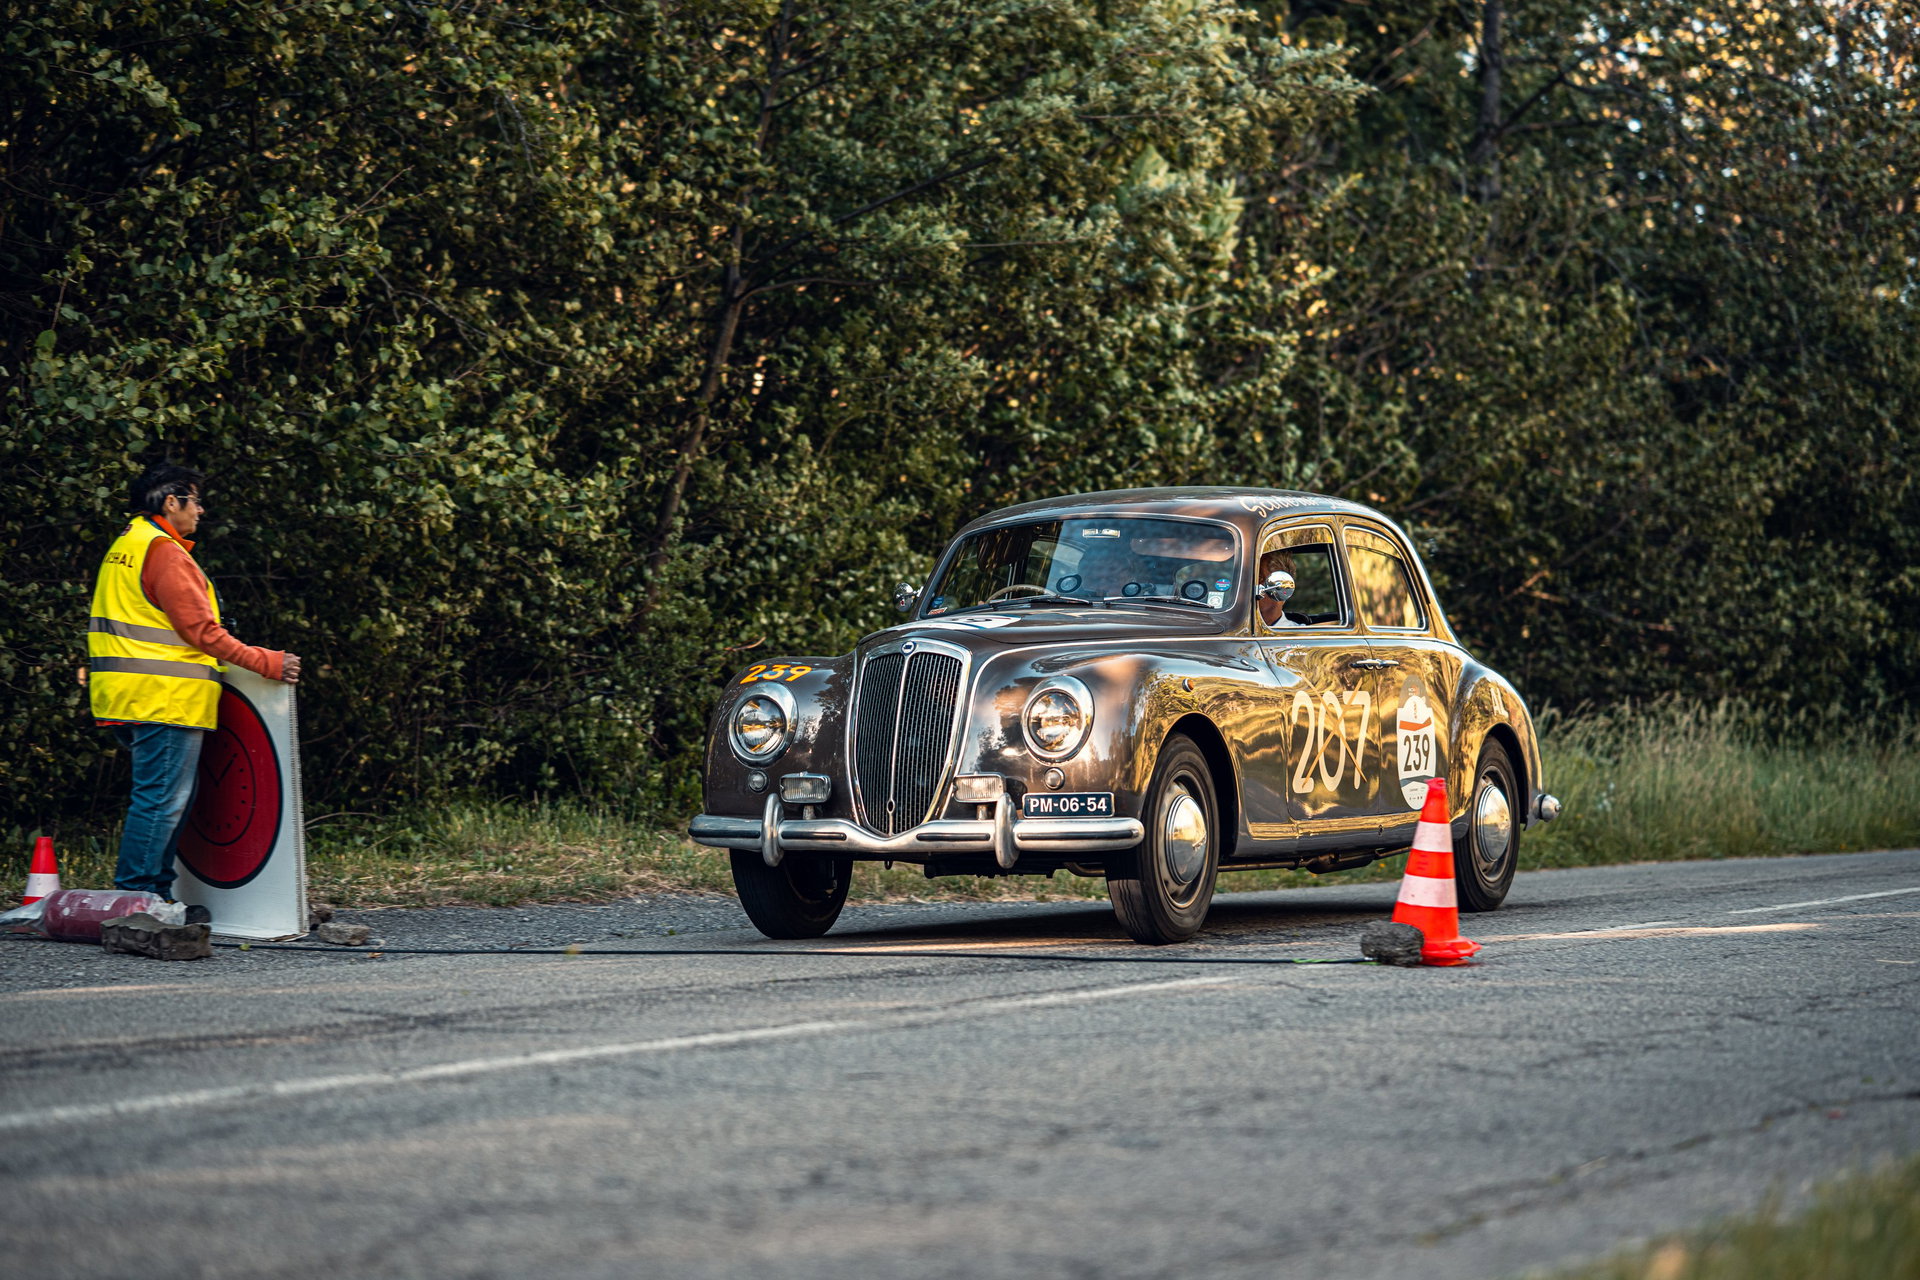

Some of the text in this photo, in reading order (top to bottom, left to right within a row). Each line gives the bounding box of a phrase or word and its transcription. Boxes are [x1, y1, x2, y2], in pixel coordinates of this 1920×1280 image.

[739, 664, 813, 684] 239
[1291, 690, 1371, 794] 207
[1403, 733, 1431, 772] 239
[1029, 797, 1108, 813] PM-06-54
